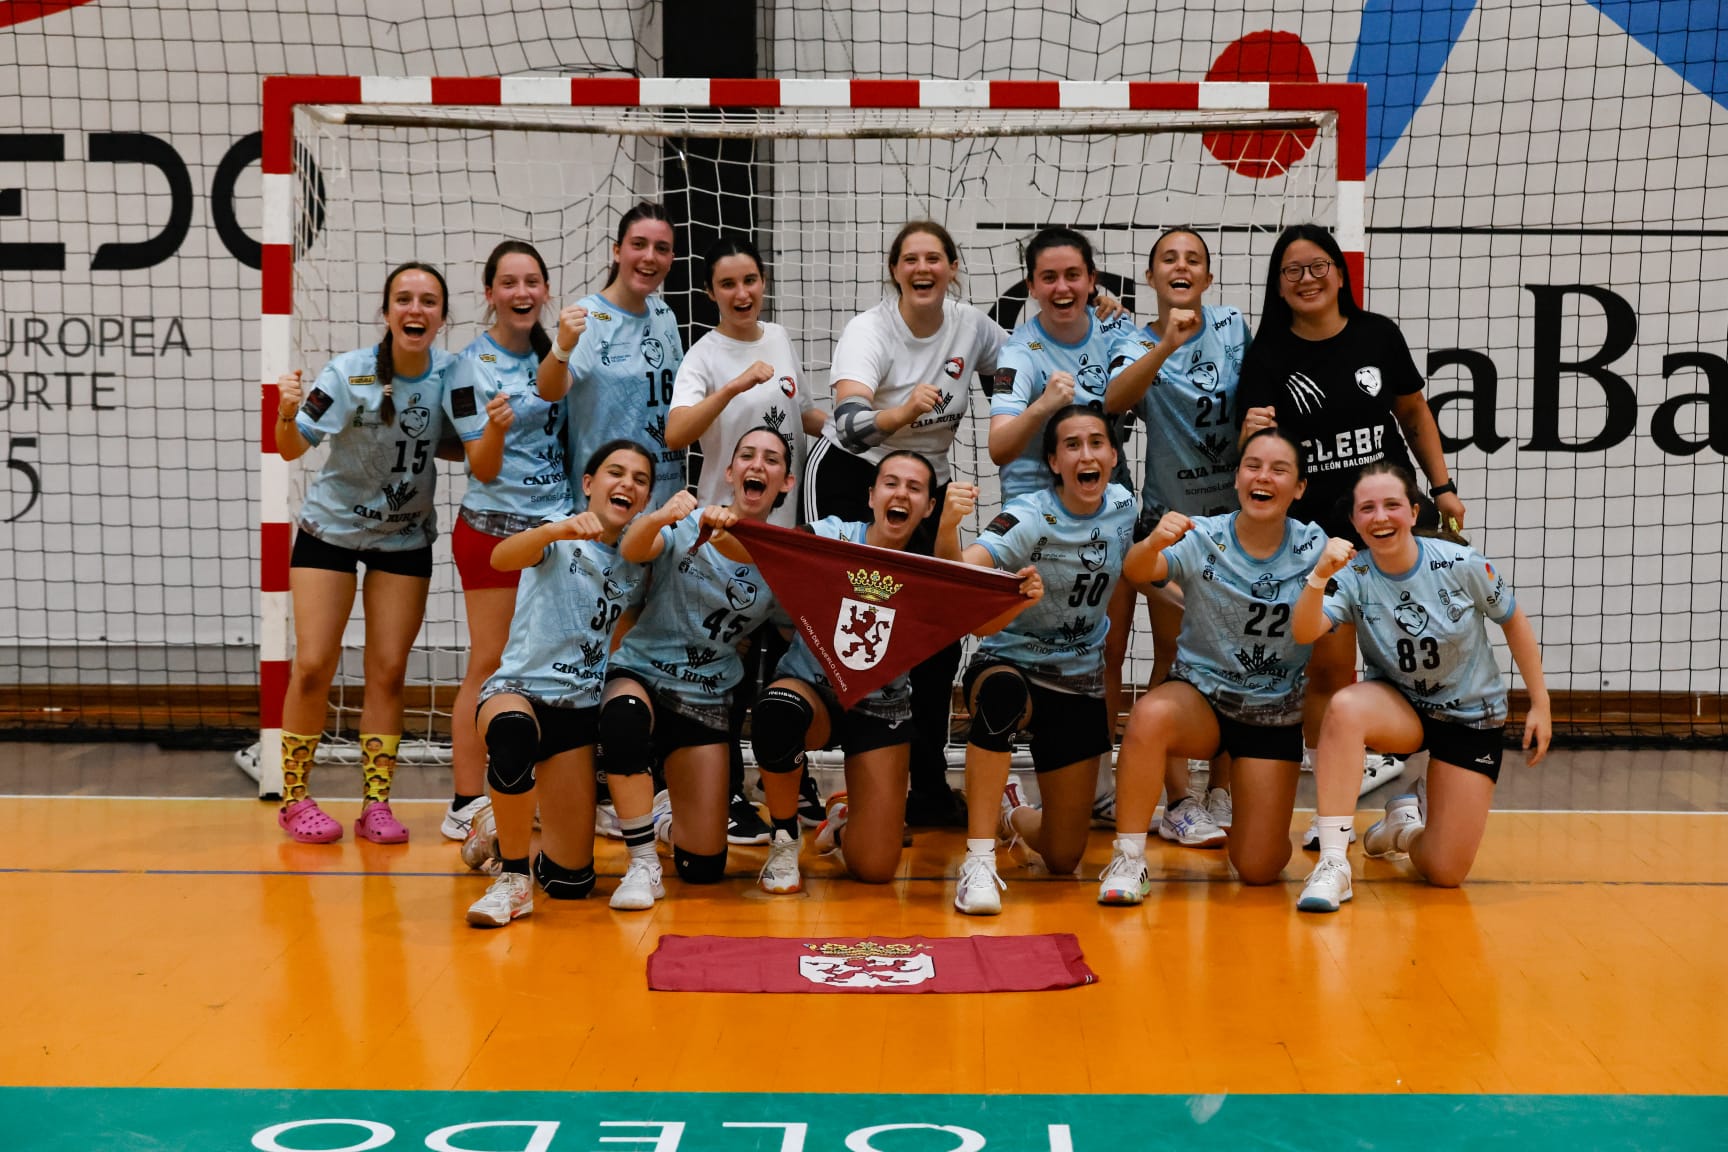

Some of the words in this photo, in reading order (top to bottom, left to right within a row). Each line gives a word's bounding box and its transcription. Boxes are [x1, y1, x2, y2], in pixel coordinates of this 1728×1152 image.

[645, 368, 672, 407] 16
[1194, 391, 1230, 428] 21
[391, 440, 430, 475] 15
[4, 437, 40, 522] 5
[1068, 572, 1109, 608] 50
[702, 607, 752, 644] 45
[1244, 602, 1290, 638] 22
[1396, 636, 1441, 673] 83
